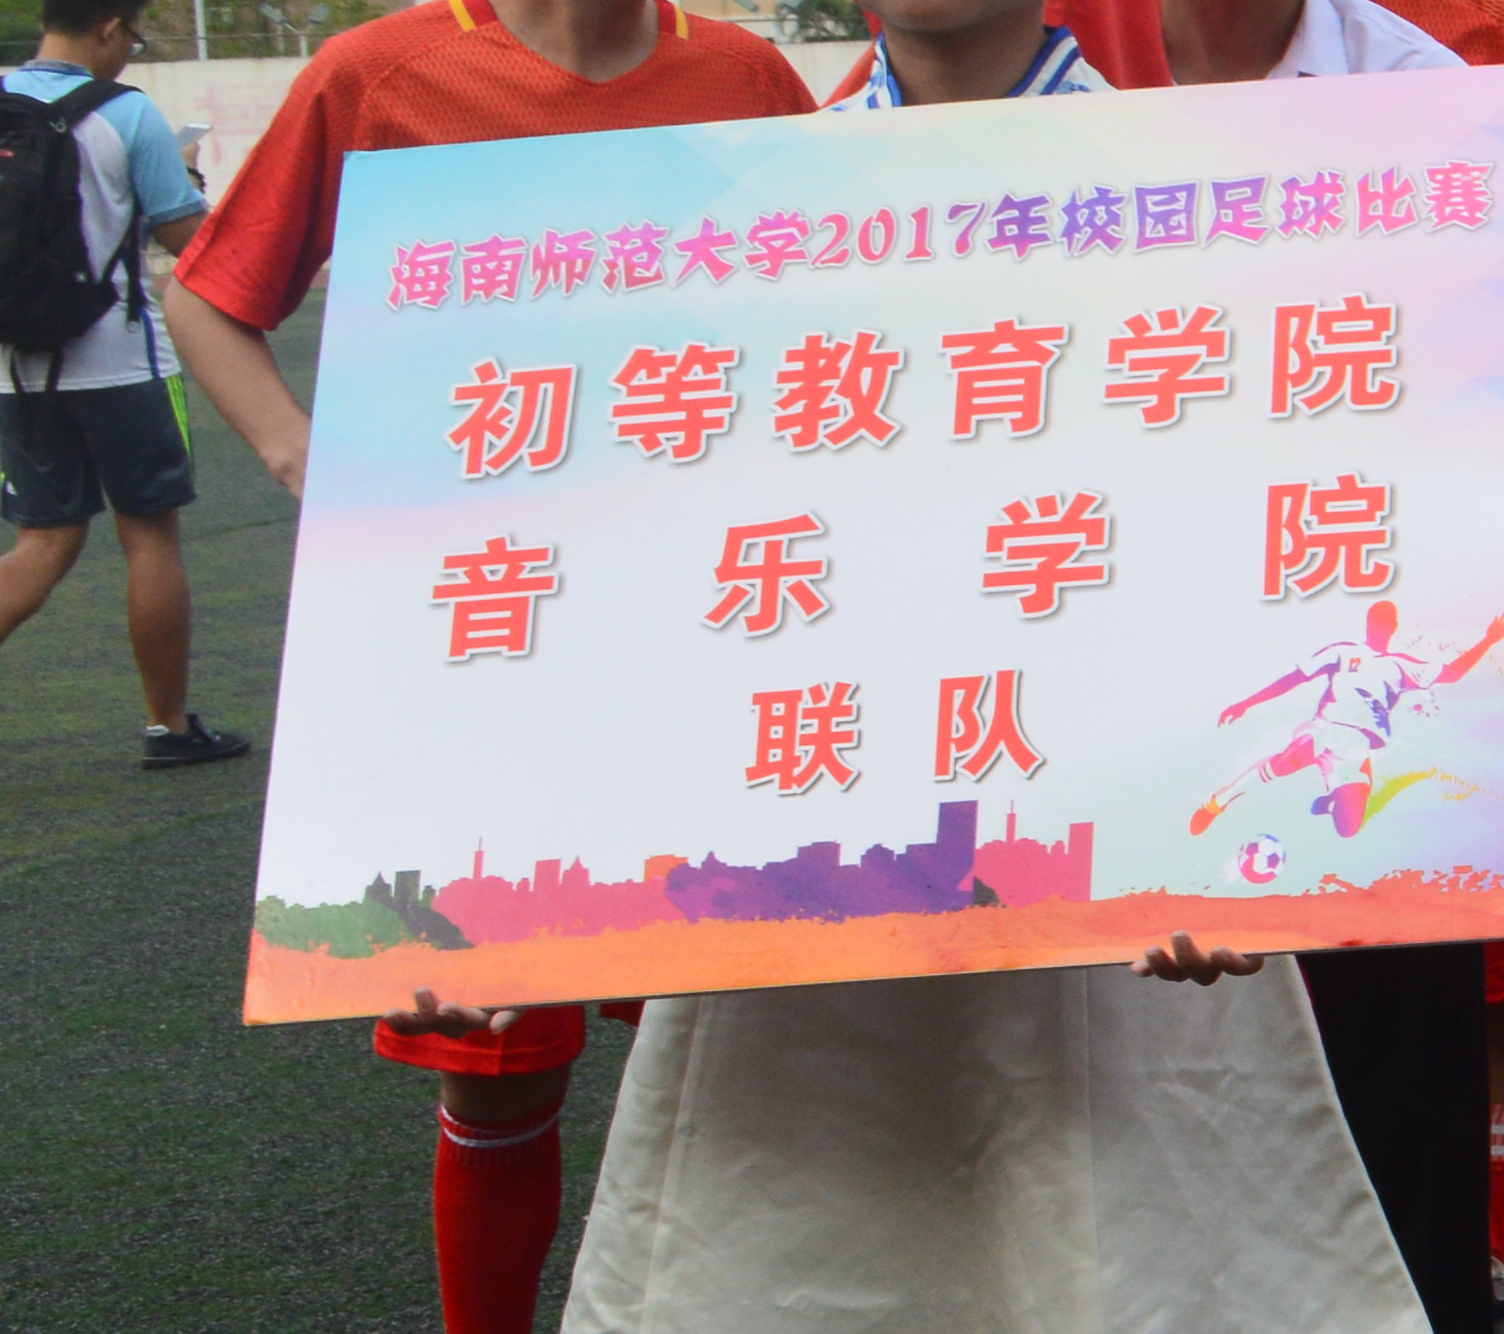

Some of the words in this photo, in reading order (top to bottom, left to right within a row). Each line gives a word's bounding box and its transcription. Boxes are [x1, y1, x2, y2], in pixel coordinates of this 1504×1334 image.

[385, 159, 1497, 310] 海南师范大学2017年校园足球比赛
[447, 296, 1400, 476] 初等教育学院
[431, 475, 1396, 660] 音乐学院
[745, 669, 1044, 792] 联队
